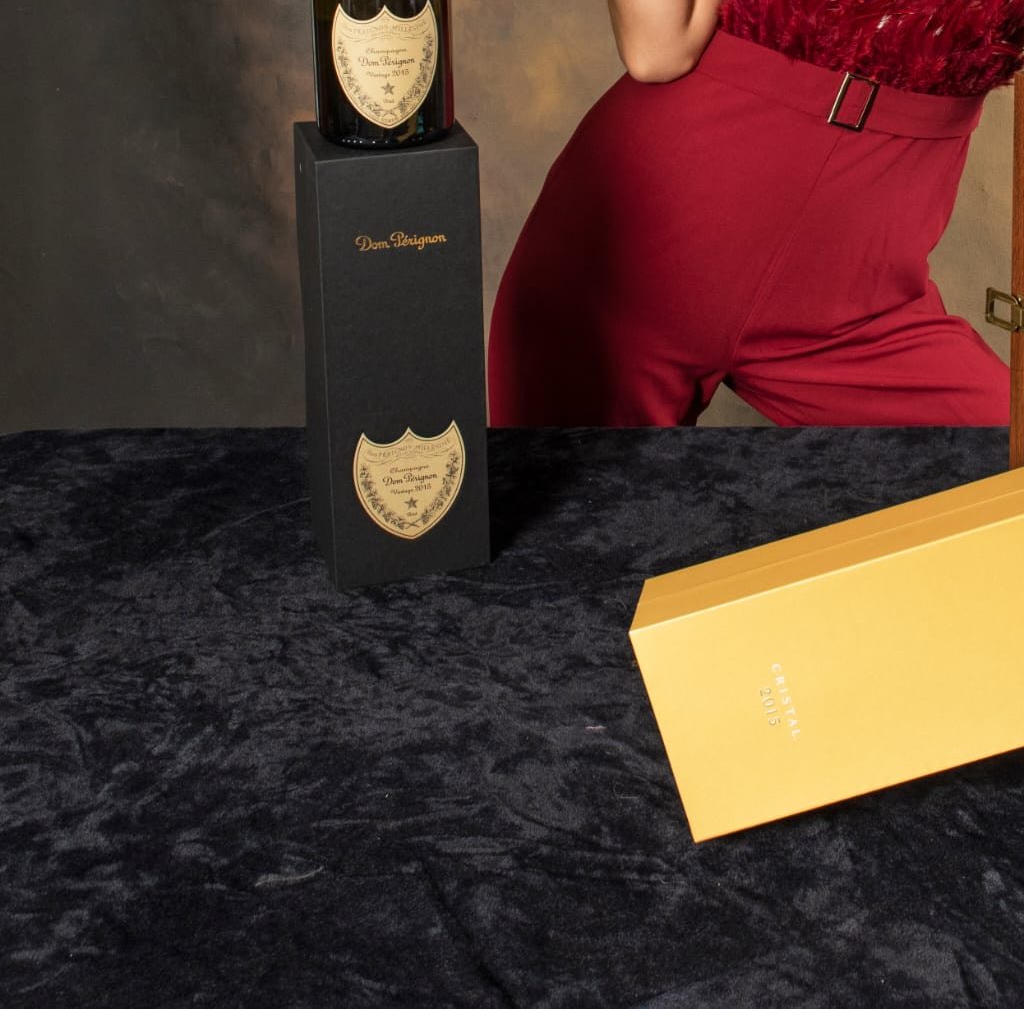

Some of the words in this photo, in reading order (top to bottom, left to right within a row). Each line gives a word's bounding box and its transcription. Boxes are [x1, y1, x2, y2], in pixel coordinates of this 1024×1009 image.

[358, 57, 380, 67] Dom
[355, 235, 391, 252] Dom
[389, 231, 448, 250] Pérignon
[382, 476, 404, 487] Dom
[759, 686, 782, 727] 2015
[771, 662, 801, 742] CRISTAL
